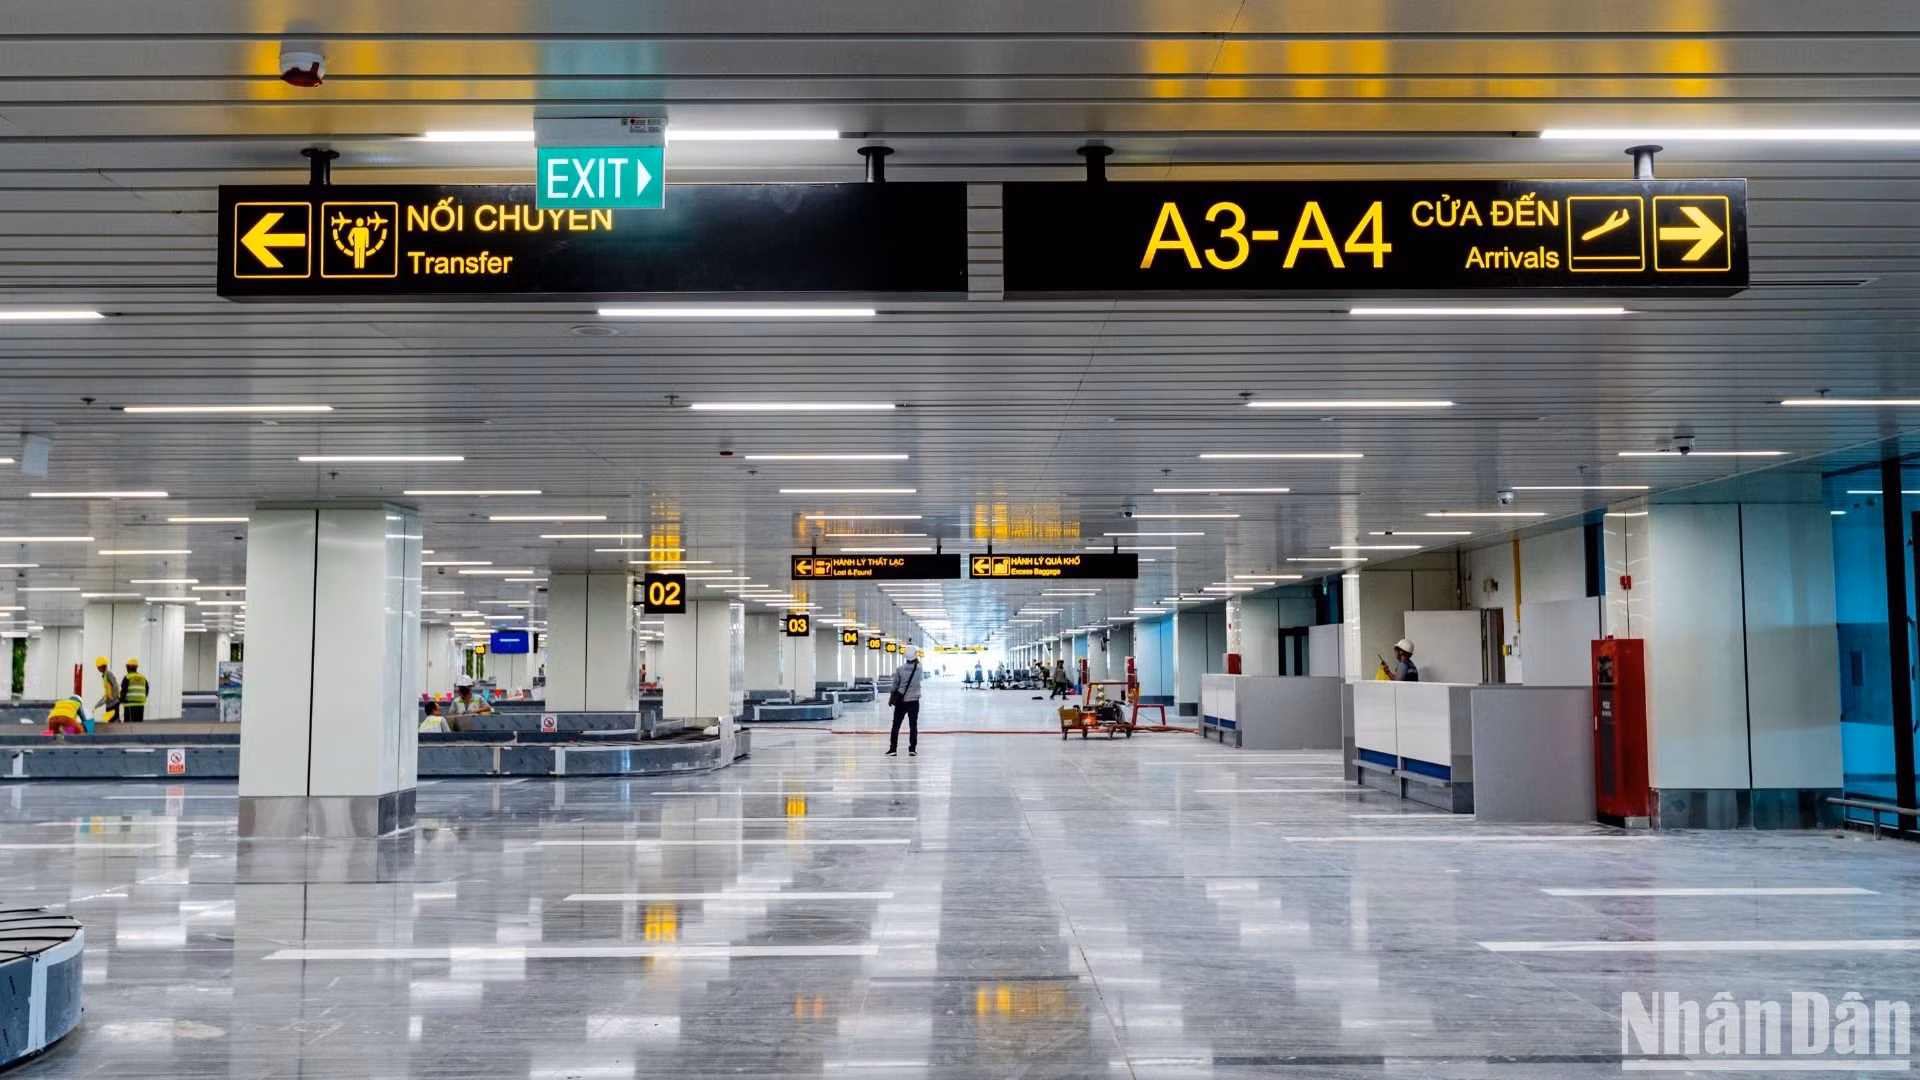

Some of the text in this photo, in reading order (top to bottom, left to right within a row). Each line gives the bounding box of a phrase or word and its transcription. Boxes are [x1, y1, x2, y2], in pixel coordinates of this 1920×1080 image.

[547, 158, 628, 198] EXIT
[407, 196, 464, 231] NỐI
[1411, 191, 1559, 227] CỬA ĐẾN
[1140, 200, 1392, 269] A3-A4
[407, 250, 513, 274] Transfer
[1465, 245, 1560, 269] Arrivals
[649, 581, 681, 606] 02
[788, 618, 808, 633] 03
[844, 632, 857, 643] 04
